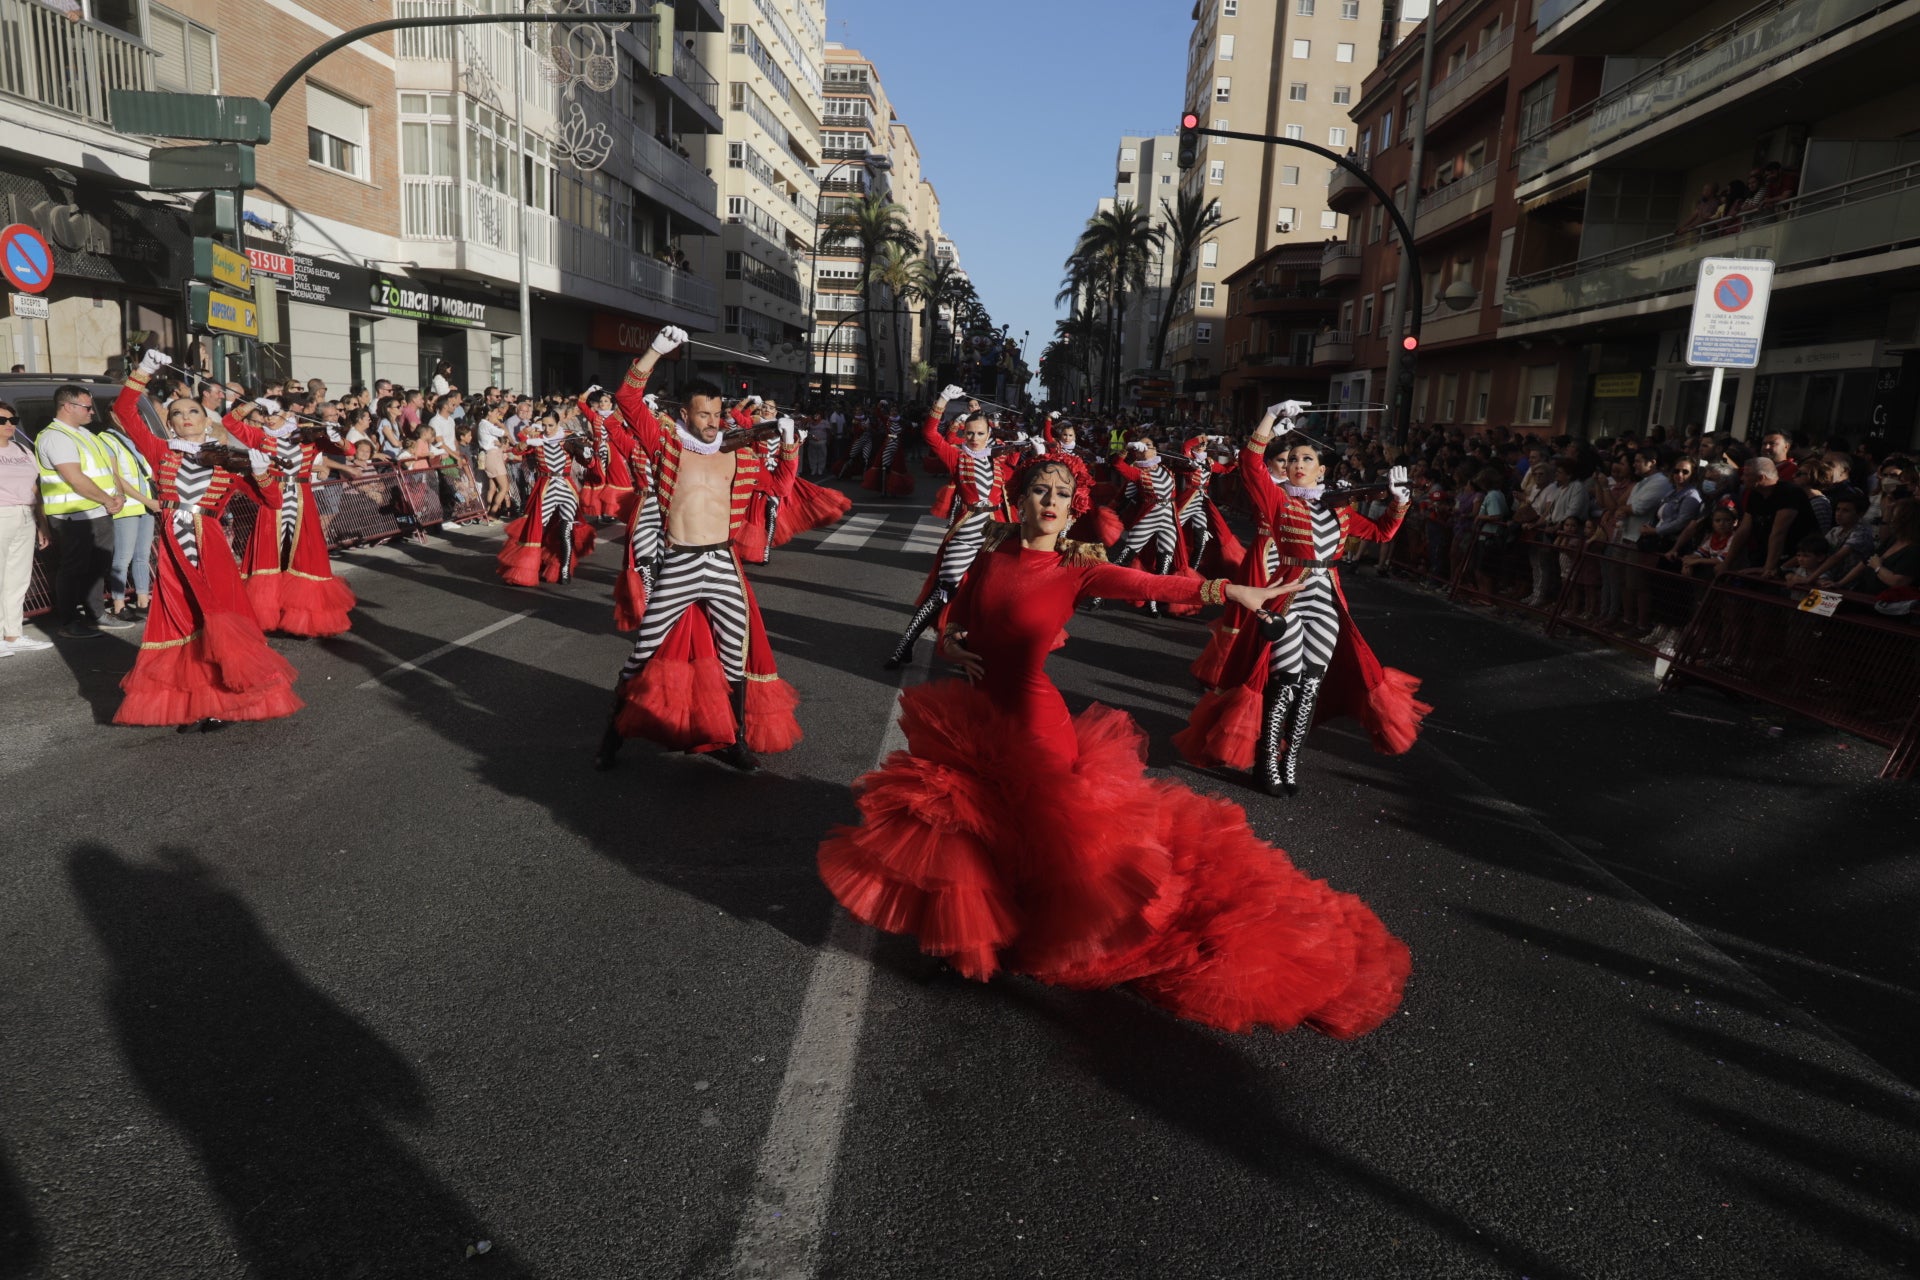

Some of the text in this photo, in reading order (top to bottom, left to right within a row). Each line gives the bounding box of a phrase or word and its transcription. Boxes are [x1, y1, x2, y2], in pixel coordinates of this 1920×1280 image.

[250, 251, 287, 272] SISUR
[20, 297, 41, 307] EXCEPTO
[441, 296, 486, 321] MOBILITY
